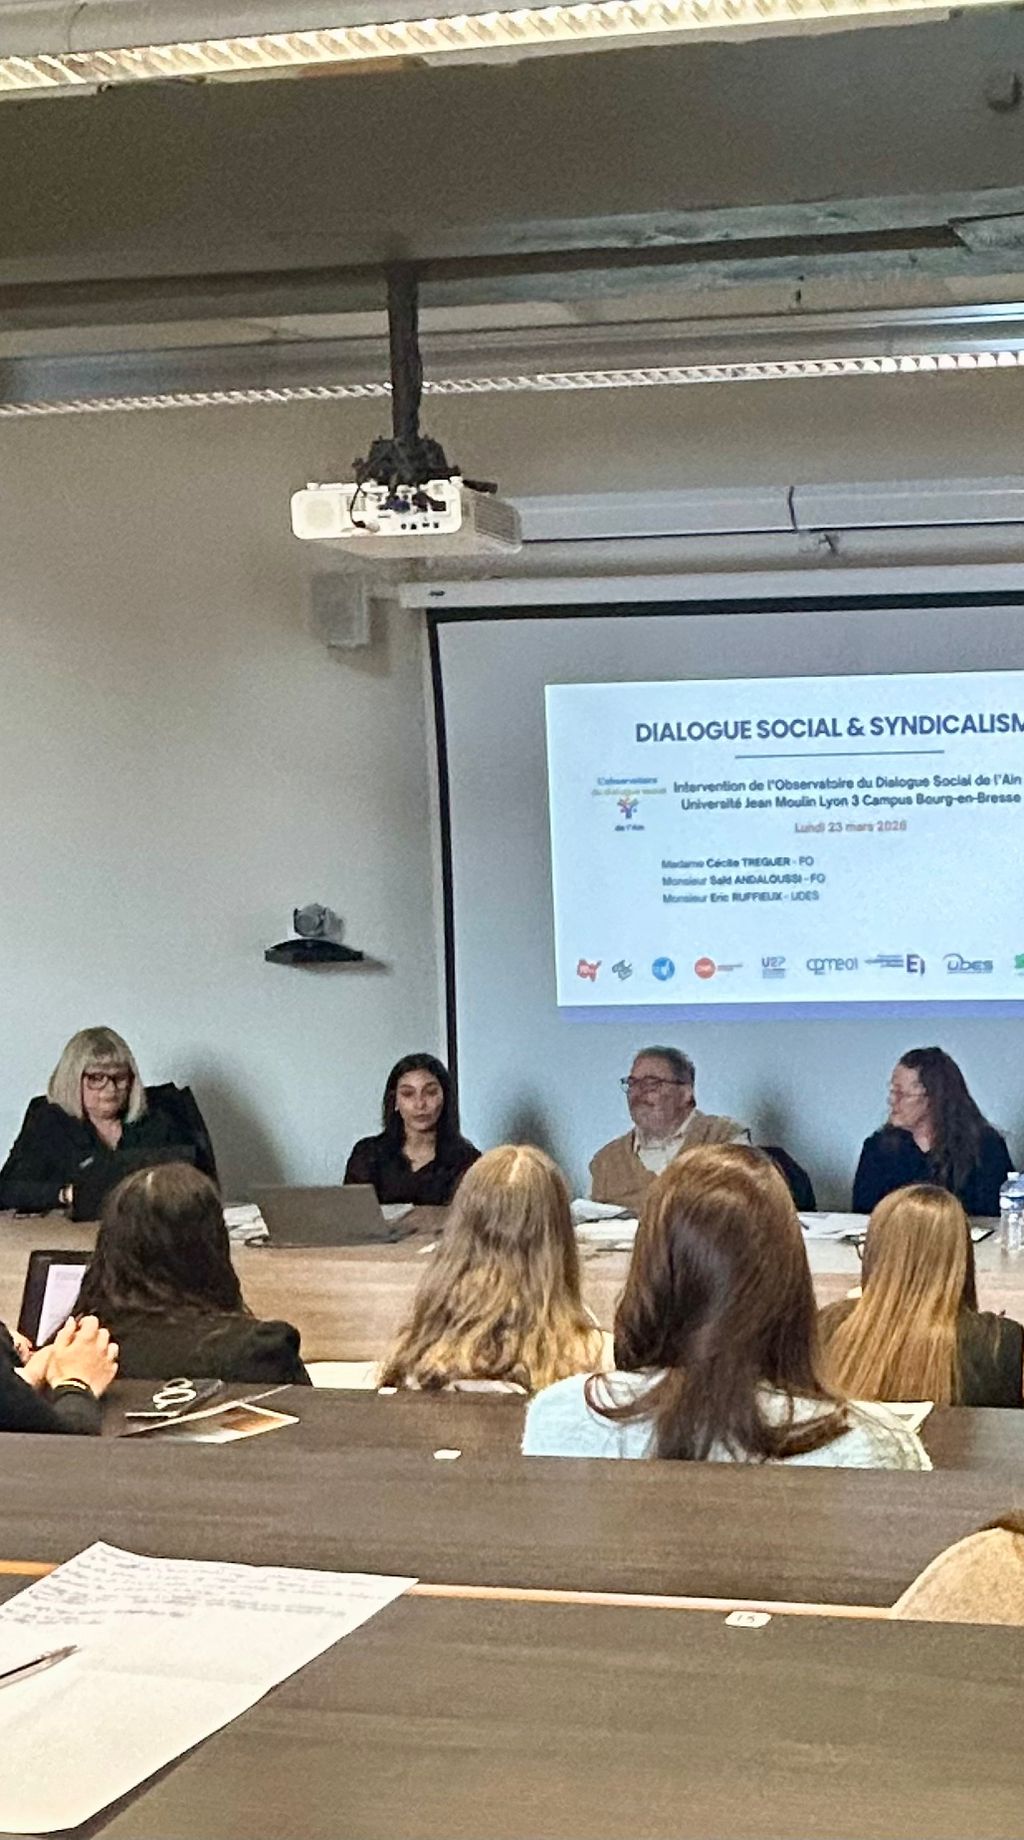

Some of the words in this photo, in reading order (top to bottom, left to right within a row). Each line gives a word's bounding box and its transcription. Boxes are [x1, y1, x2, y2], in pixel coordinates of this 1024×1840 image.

[636, 720, 752, 742] DIALOGUE
[757, 717, 842, 739] SOCIAL
[847, 717, 865, 736] &
[674, 780, 747, 793] Intervention
[749, 781, 764, 791] de
[767, 777, 854, 791] l'Observatoire
[857, 776, 873, 788] du
[876, 775, 930, 790] Dialogue
[933, 774, 972, 787] Social
[975, 774, 990, 786] de
[994, 773, 1022, 785] l'Ain
[682, 796, 742, 810] Université
[745, 797, 772, 809] Jean
[775, 795, 816, 808] Moulin
[819, 794, 849, 810] Lyon
[852, 794, 860, 806] 3
[862, 793, 913, 808] Campus
[916, 791, 1022, 807] Bourg-en-Bresse
[794, 822, 825, 833] Lundi
[828, 821, 843, 833] 23
[845, 822, 875, 832] mars
[799, 856, 814, 866] FO
[734, 873, 802, 884] ANDALOUSSI
[810, 873, 826, 884] FO
